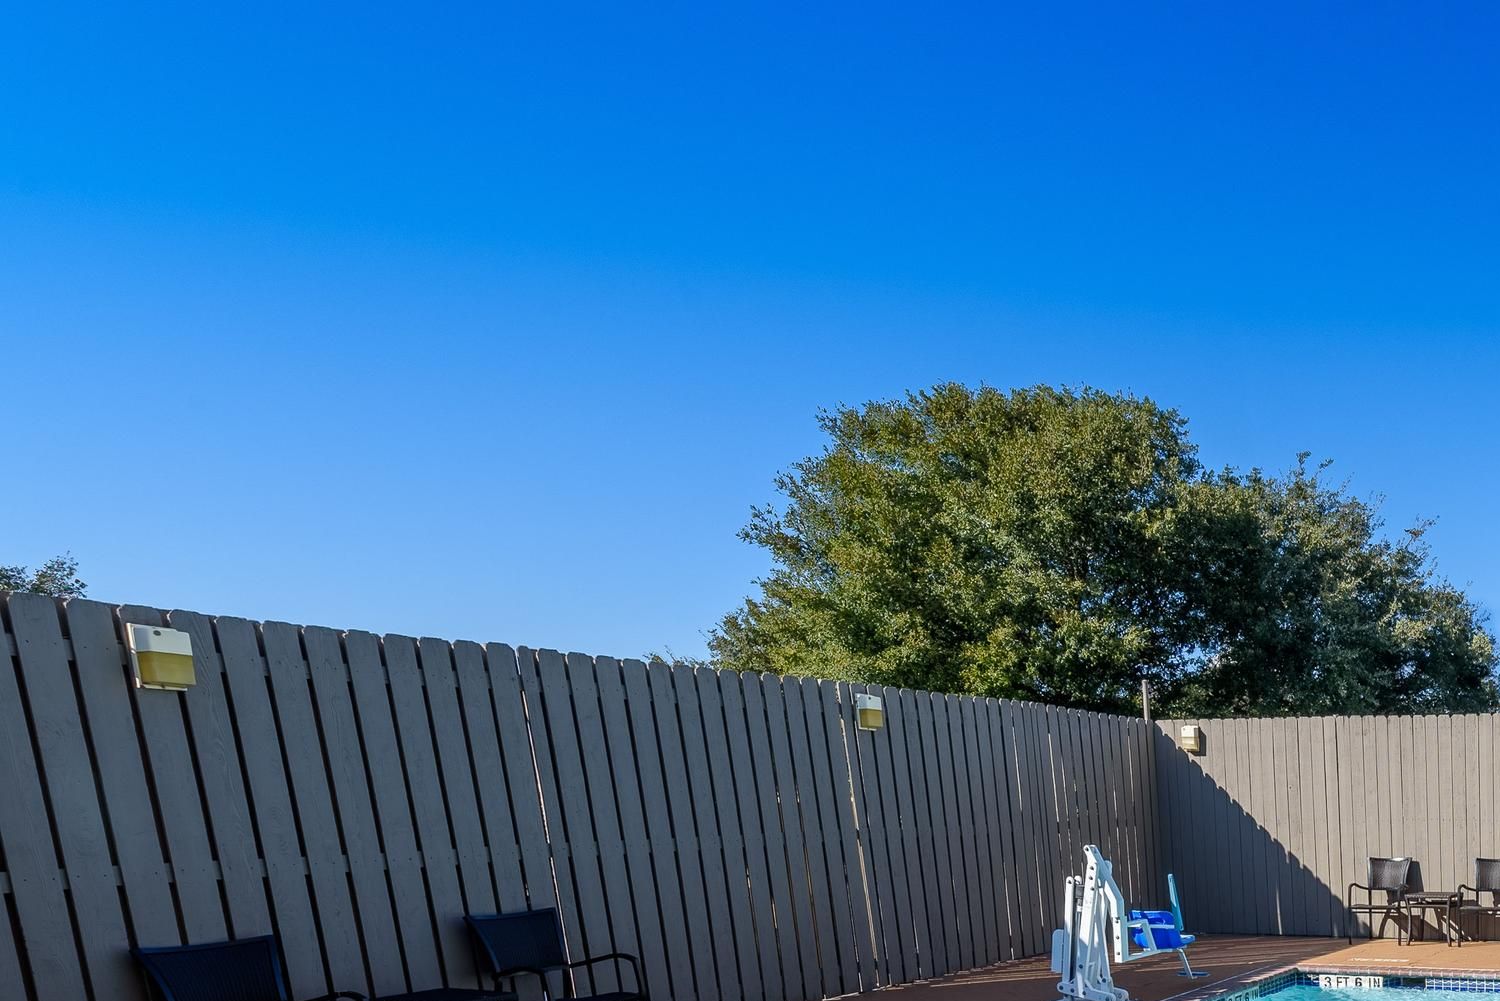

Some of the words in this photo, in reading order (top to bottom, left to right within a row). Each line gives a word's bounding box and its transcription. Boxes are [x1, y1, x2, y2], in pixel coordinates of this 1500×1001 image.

[1324, 976, 1332, 987] 3
[1336, 977, 1349, 988] FT
[1354, 977, 1363, 987] 6
[1368, 977, 1380, 988] IN
